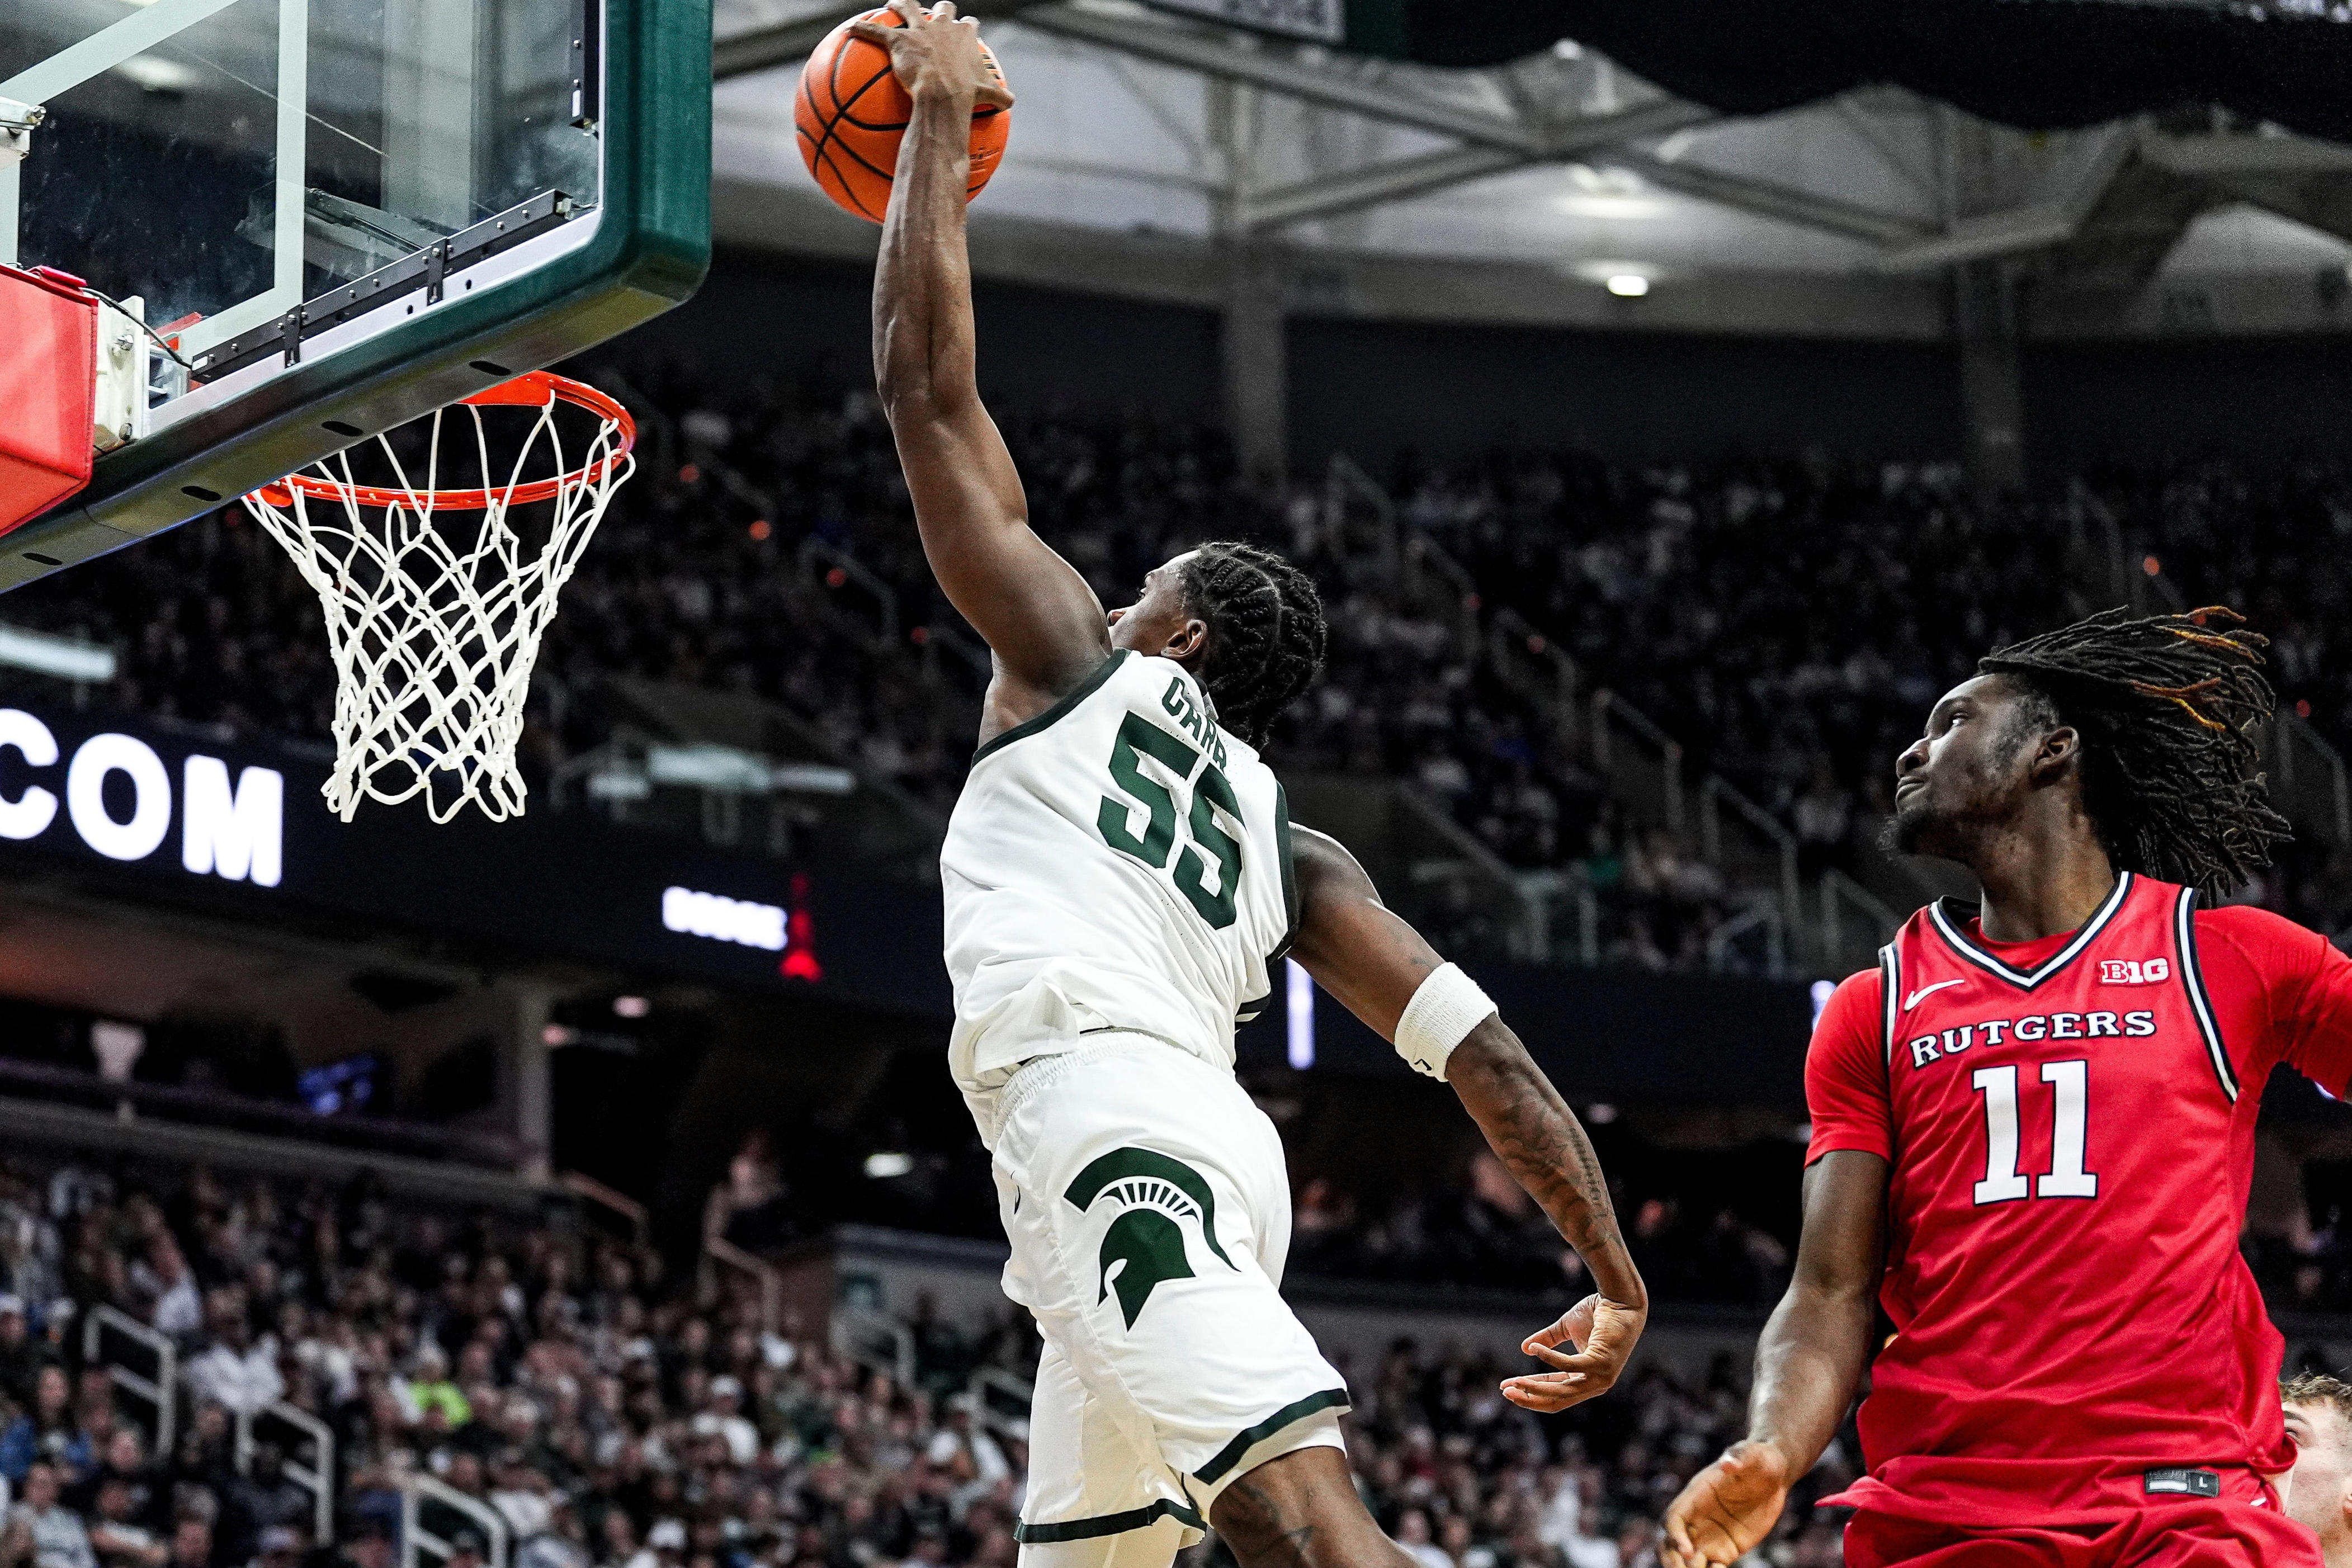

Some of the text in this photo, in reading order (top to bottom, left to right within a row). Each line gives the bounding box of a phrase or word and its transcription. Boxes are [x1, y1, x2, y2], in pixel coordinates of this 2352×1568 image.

[1161, 677, 1227, 774] CARR
[1097, 710, 1246, 931] 55
[1909, 1010, 2157, 1069] RUTGERS
[1972, 1060, 2098, 1205] 11
[2198, 1476, 2208, 1488] L
